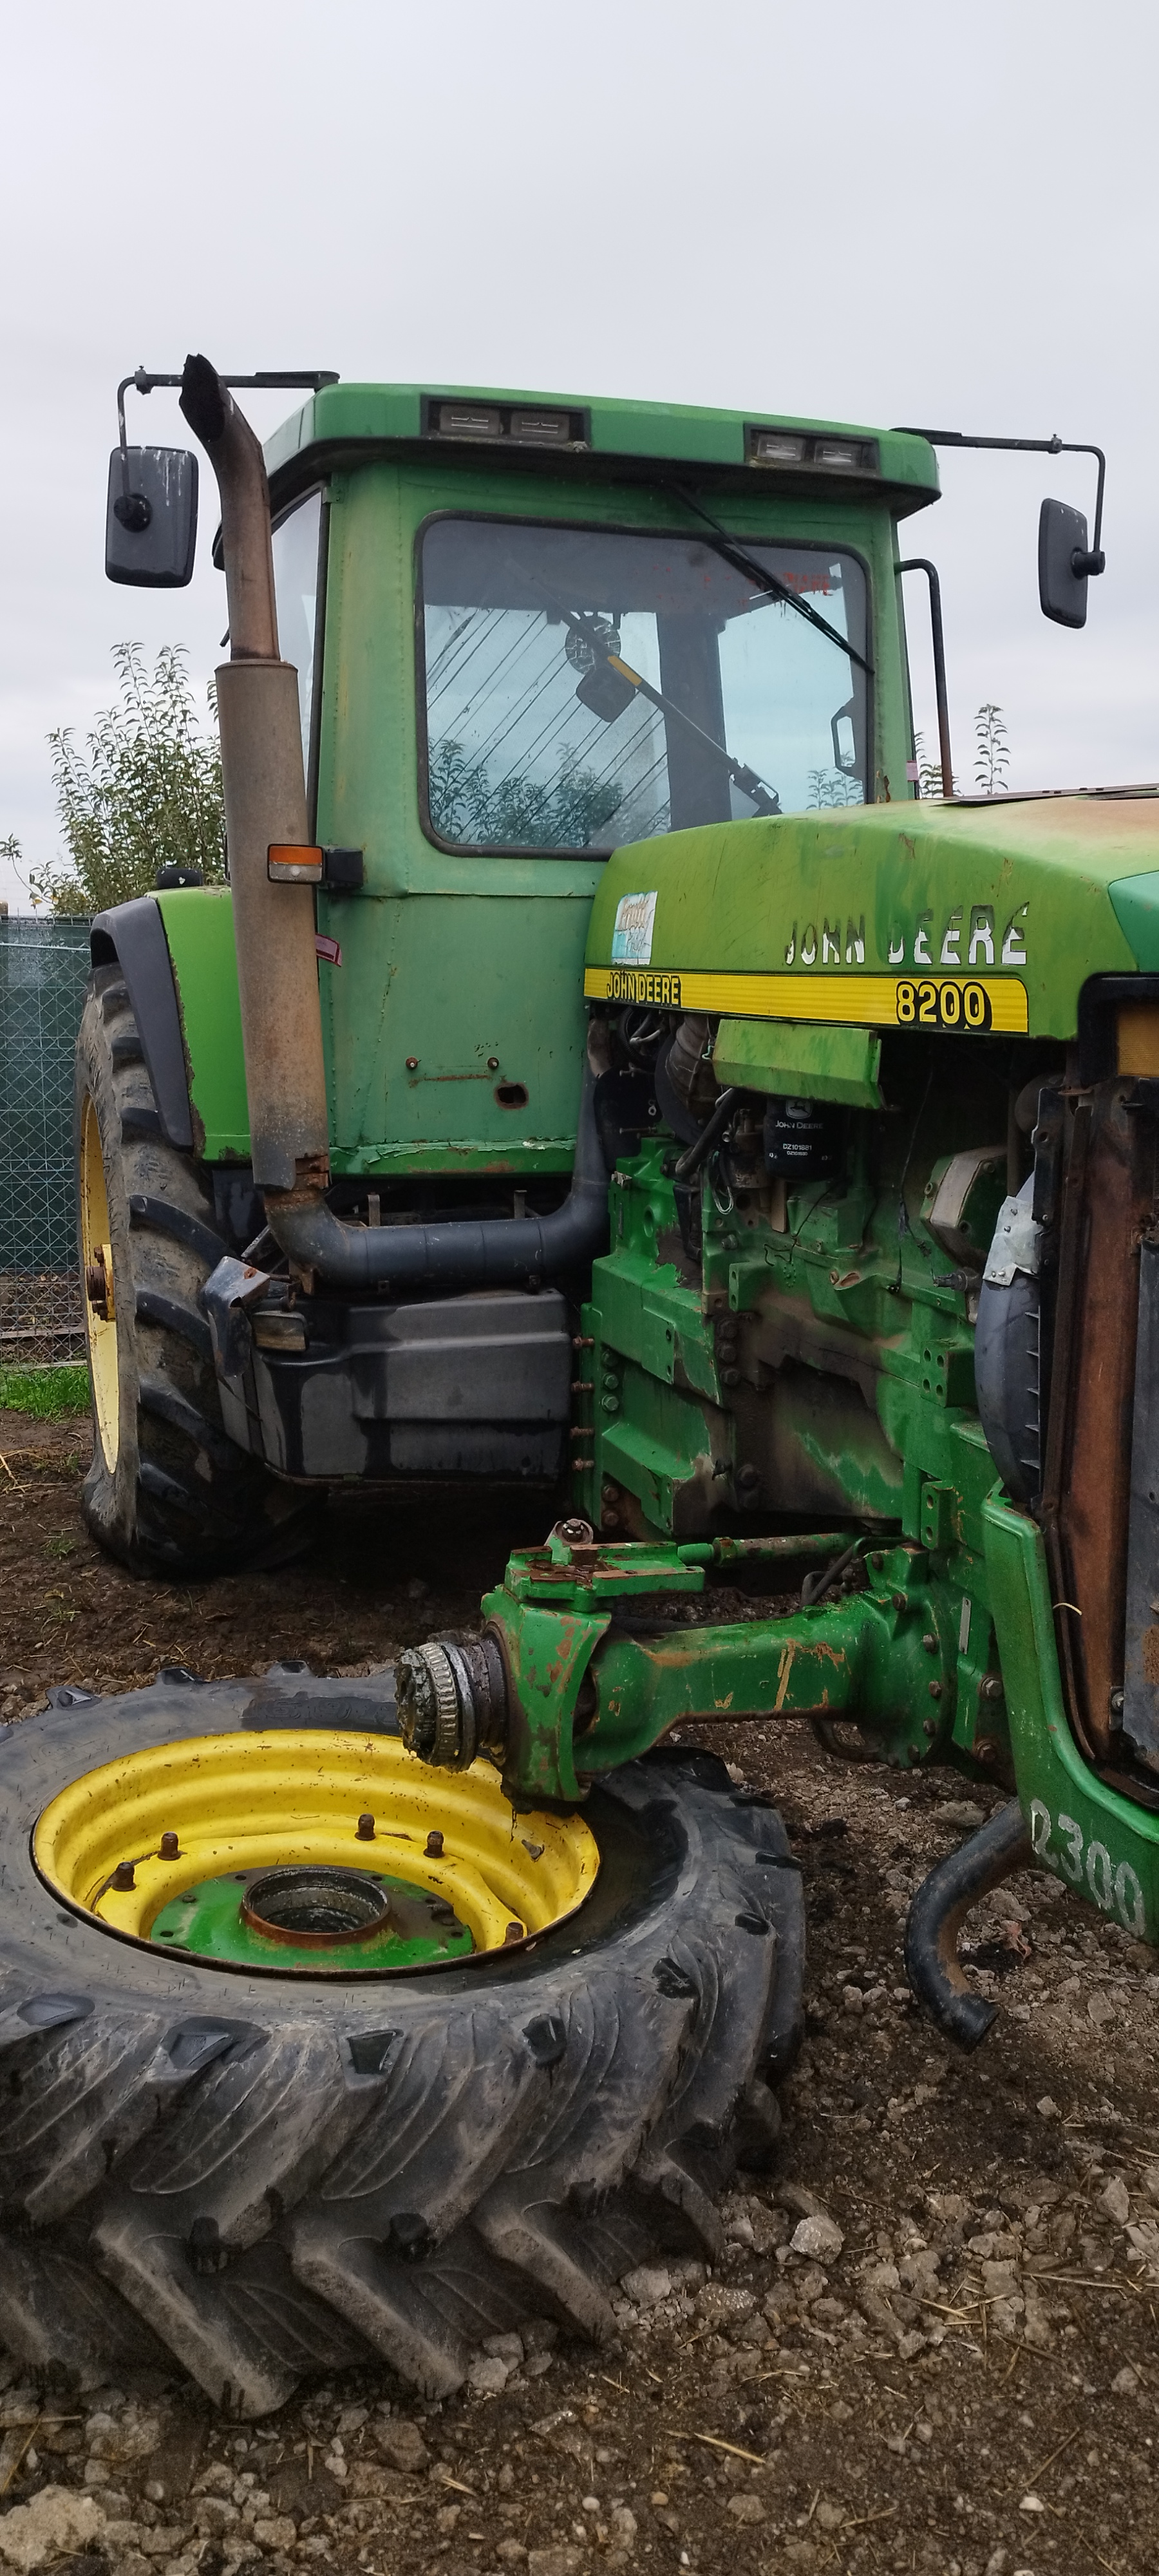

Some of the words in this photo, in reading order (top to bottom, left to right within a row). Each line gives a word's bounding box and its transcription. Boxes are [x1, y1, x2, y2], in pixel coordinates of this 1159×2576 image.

[785, 914, 866, 965] JOHN
[607, 971, 636, 1000] JOHN
[638, 974, 680, 1005] DEERE
[897, 982, 987, 1028] 8200
[775, 1120, 795, 1129] JOHN
